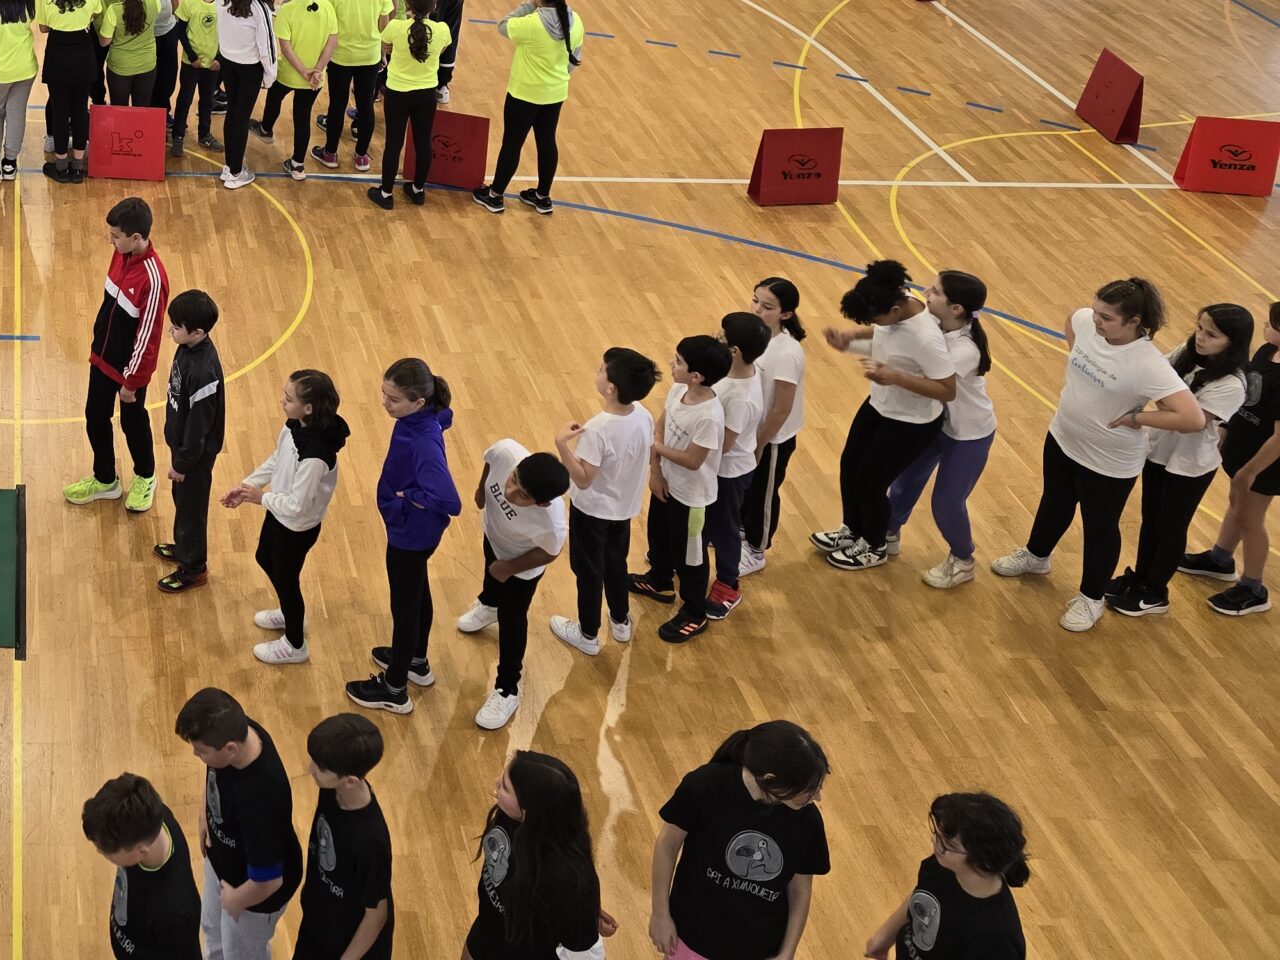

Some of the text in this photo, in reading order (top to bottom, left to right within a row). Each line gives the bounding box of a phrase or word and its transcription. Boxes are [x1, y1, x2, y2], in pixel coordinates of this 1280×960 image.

[1210, 159, 1256, 171] Yenza
[781, 170, 821, 180] Yenza
[490, 483, 517, 520] BLUE
[723, 877, 730, 888] A
